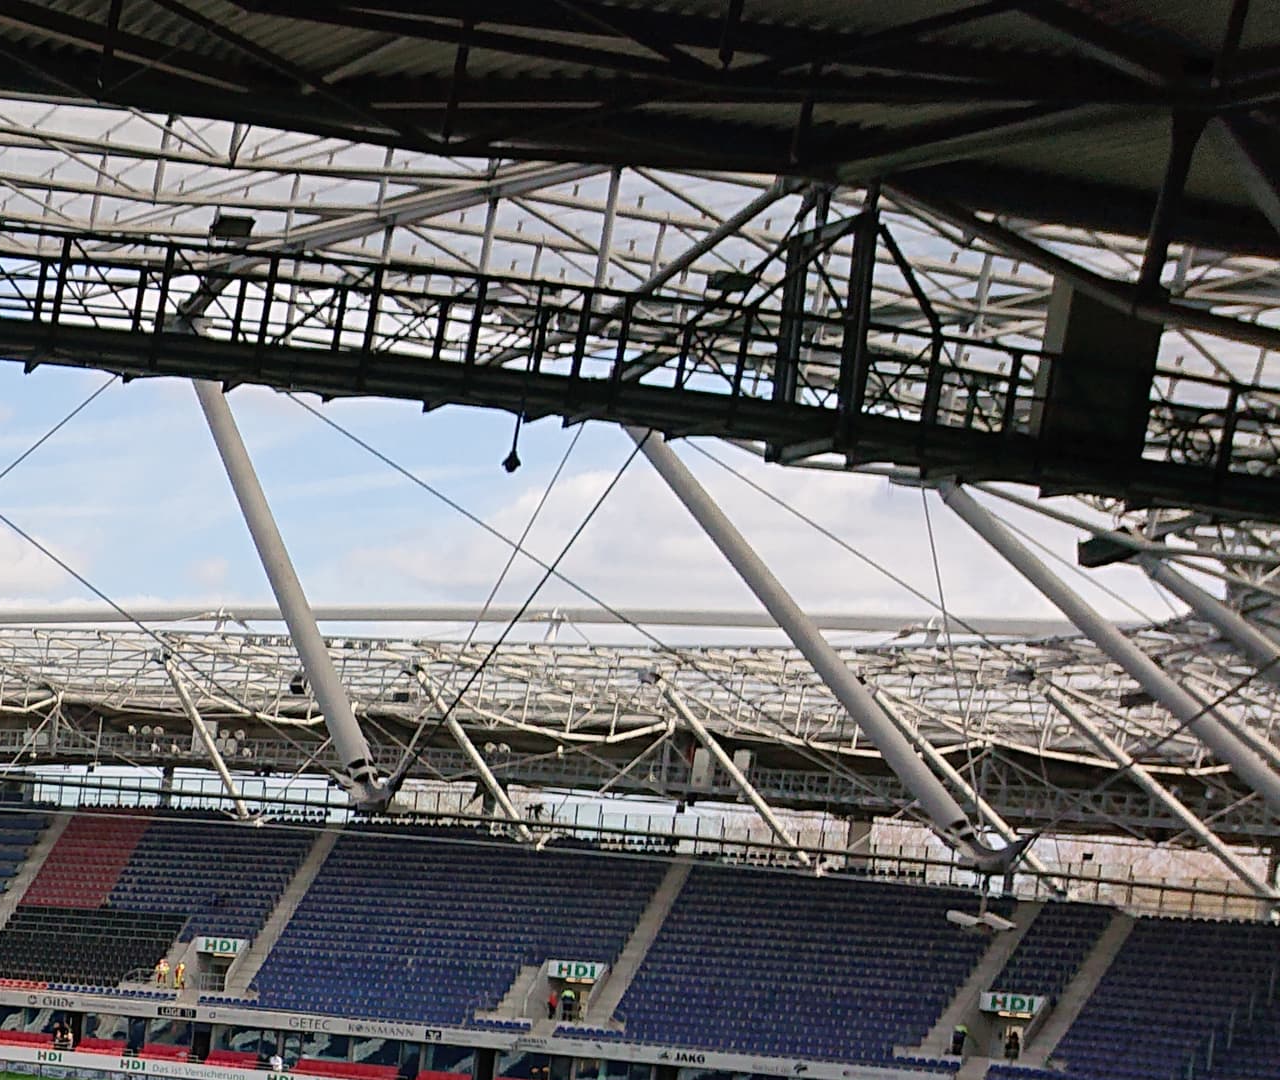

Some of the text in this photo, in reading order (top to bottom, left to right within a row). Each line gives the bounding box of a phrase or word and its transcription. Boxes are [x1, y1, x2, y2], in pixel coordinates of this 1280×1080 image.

[204, 939, 237, 952] HDI
[557, 963, 596, 977] HDI
[991, 996, 1035, 1011] HDI
[289, 1017, 329, 1030] GETEC
[37, 1051, 62, 1062] HDI
[674, 1052, 705, 1064] JAKO
[120, 1059, 146, 1071] HDI
